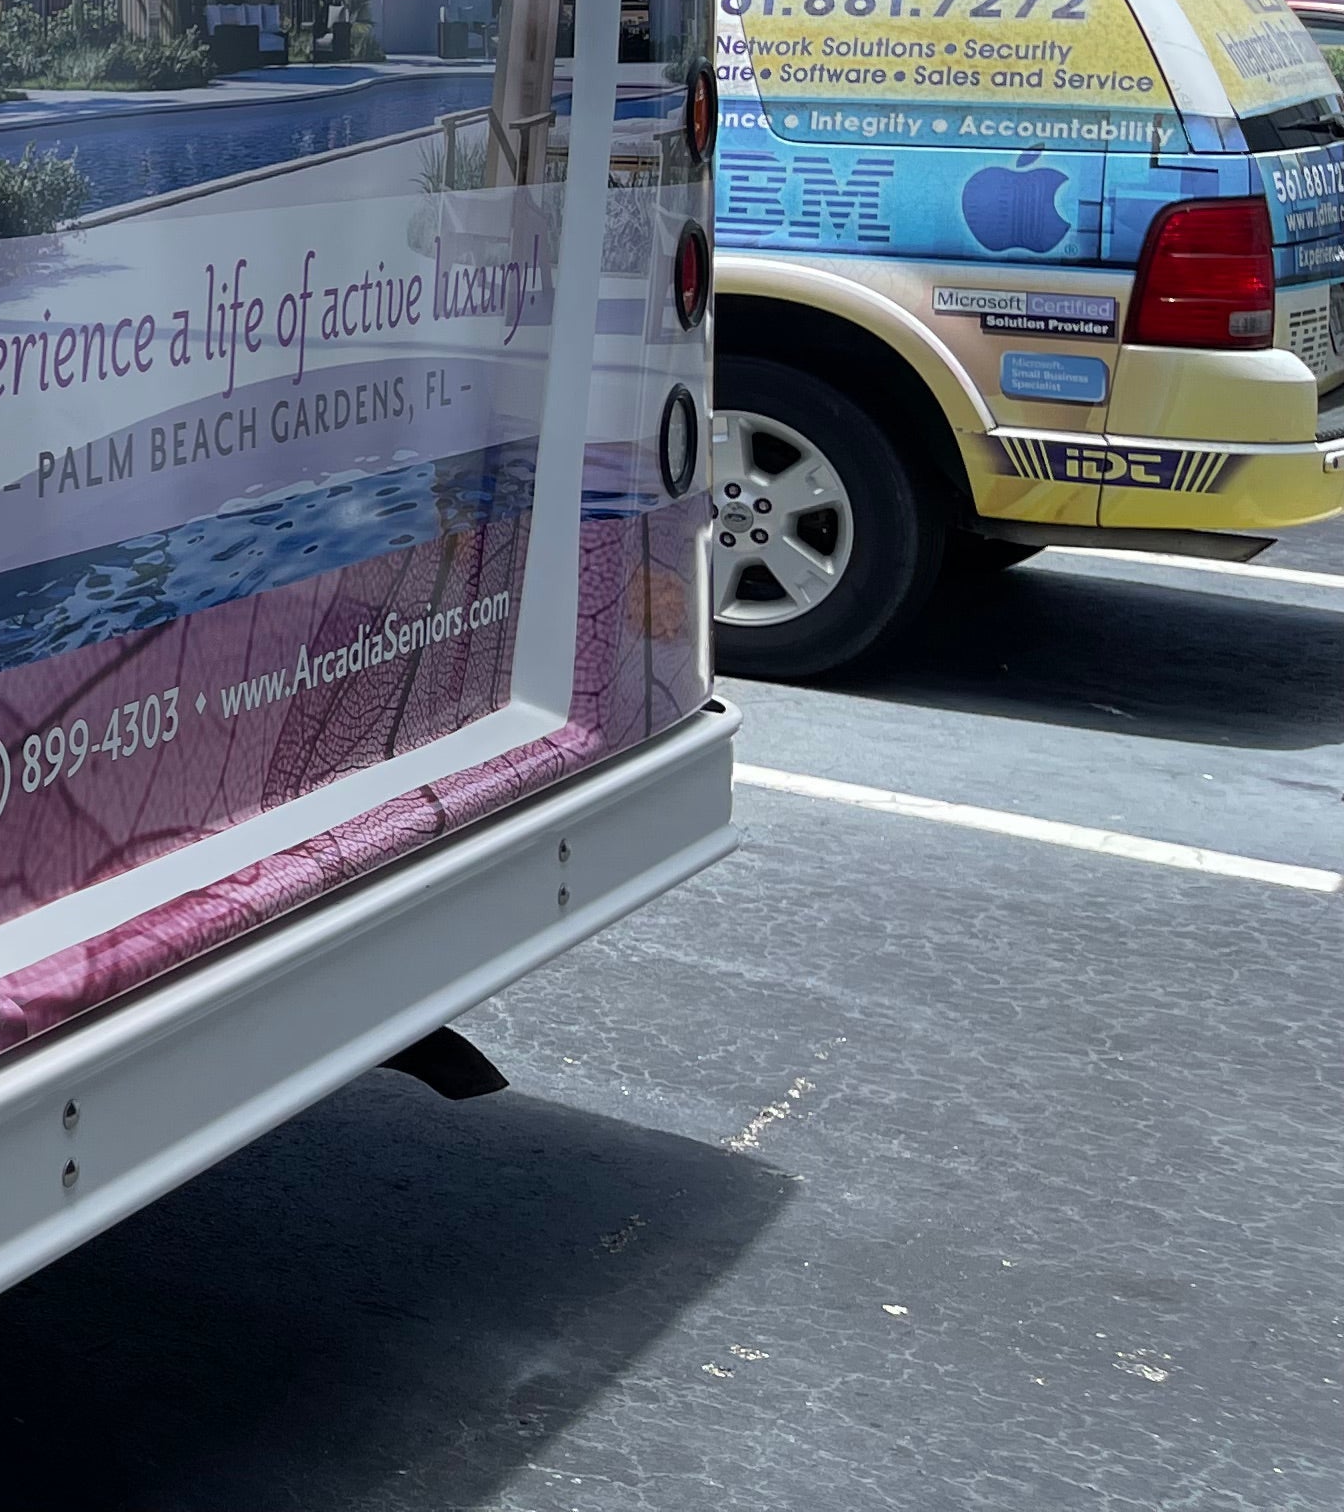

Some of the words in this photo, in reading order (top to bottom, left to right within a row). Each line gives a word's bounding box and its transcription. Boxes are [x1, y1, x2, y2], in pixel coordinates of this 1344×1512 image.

[716, 35, 813, 56] Network
[822, 37, 937, 58] Solutions
[963, 38, 1072, 65] Security
[779, 62, 887, 84] Software
[914, 65, 981, 87] Sales
[991, 69, 1043, 88] and
[1053, 69, 1154, 92] Service
[811, 110, 922, 137] Integrity
[959, 115, 1174, 146] Accountability
[1272, 161, 1344, 204] 561.881.72
[171, 310, 191, 367] a
[205, 258, 262, 398] life
[278, 250, 316, 386] of
[321, 261, 422, 341] active
[433, 234, 541, 346] luxury!
[937, 291, 1025, 311] Microsoft
[1031, 297, 1111, 317] Certified
[986, 315, 1045, 330] Solution
[1048, 319, 1109, 335] Provider
[38, 442, 134, 499] PALM
[150, 407, 257, 472] BEACH
[271, 375, 414, 445] GARDENS,
[426, 369, 452, 411] FL
[21, 686, 181, 793] 899-4303
[220, 589, 510, 719] www.ArcadiaSeniors.com
